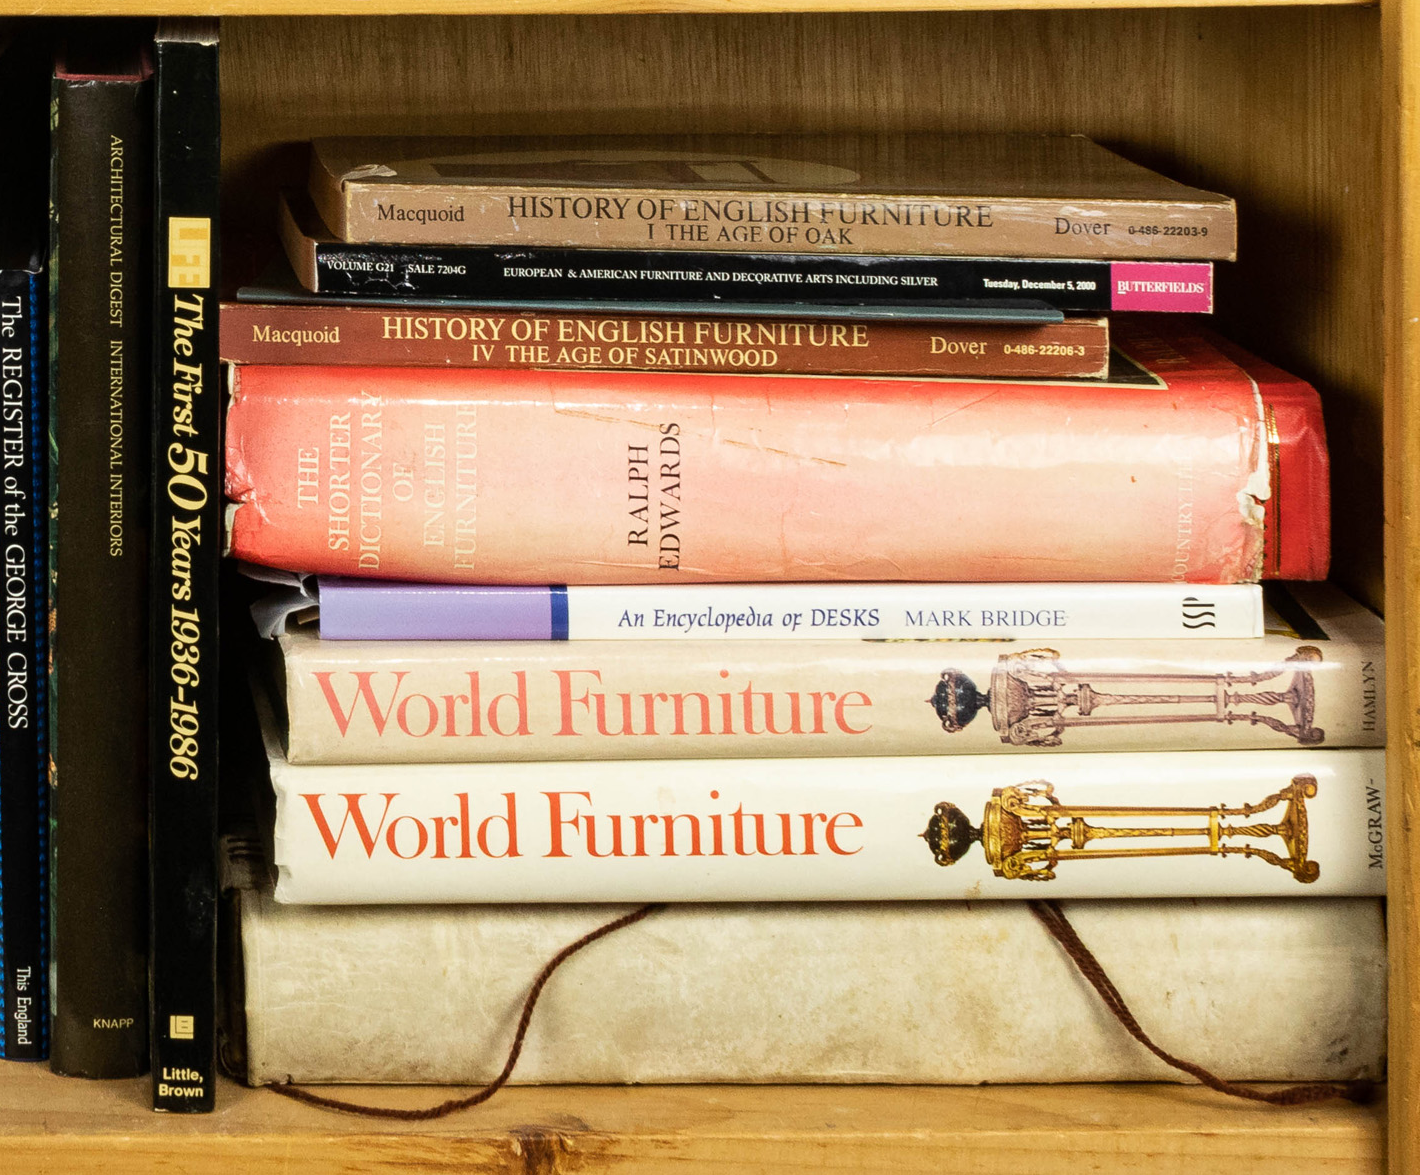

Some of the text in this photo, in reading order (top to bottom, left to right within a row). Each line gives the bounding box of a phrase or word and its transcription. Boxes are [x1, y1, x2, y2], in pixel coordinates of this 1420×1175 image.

[983, 278, 1096, 292] Tuesday, December 5, 2000
[1118, 280, 1204, 295] BUTTERFIELDS
[252, 324, 340, 343] Macquoid
[472, 345, 778, 367] IV THE AGE OF SATINWOOD
[930, 337, 1085, 357] Dover 0-486-22206-3
[628, 444, 648, 547] RALPH
[658, 423, 681, 571] EDWARDS
[618, 607, 880, 634] An Encyclopedia of DESKS
[905, 609, 1068, 627] MARK BRIDGE
[298, 789, 864, 859] World Furniture
[93, 1018, 133, 1029] KNAPP
[162, 1068, 204, 1082] Little,
[158, 1083, 203, 1098] Brown
